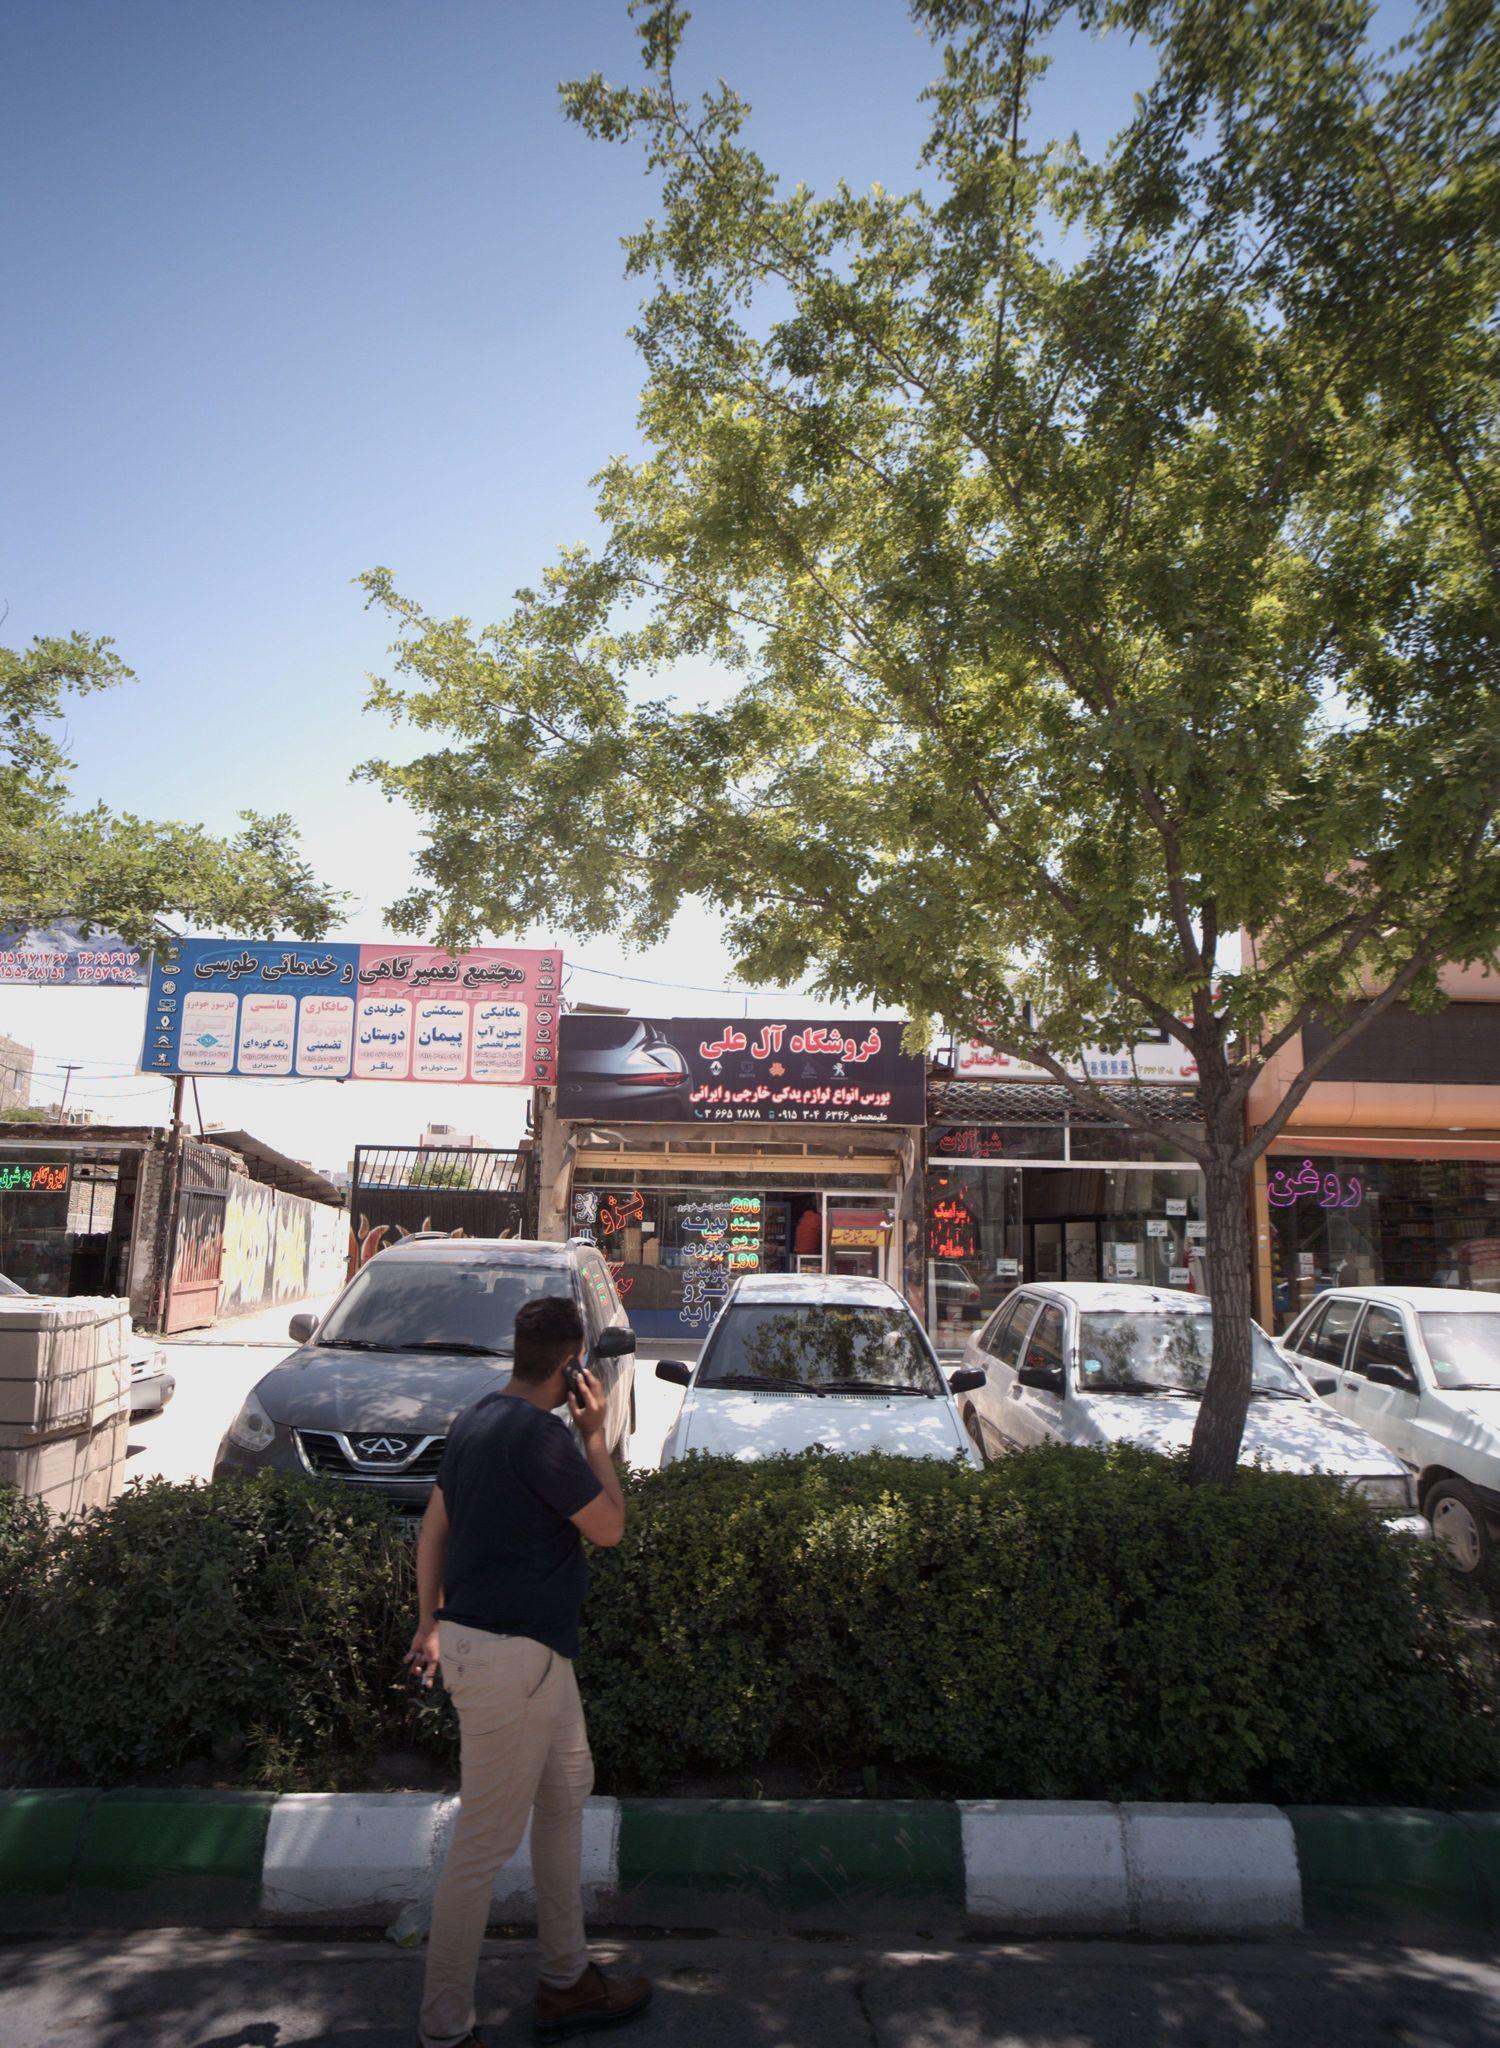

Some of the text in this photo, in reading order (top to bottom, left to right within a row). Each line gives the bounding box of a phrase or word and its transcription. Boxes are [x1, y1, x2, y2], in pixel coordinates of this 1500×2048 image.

[195, 951, 259, 980] طوسی
[261, 953, 338, 981] خدماتی
[340, 965, 354, 984] و
[463, 962, 526, 988] مجتمع
[244, 983, 347, 996] MOTORS
[362, 986, 525, 1001] HYUNDAI
[250, 1001, 288, 1012] نقاشی
[305, 1001, 349, 1014] صافکاری
[364, 1004, 406, 1017] جلوبندی
[422, 1004, 464, 1018] سیمکشی
[481, 1007, 521, 1019] مکانیکی
[360, 1027, 406, 1045] دوستان
[418, 1026, 463, 1048] پیمان
[699, 1024, 882, 1063] فروشگاه آل علی
[306, 1039, 342, 1052] تضمینی
[370, 1061, 394, 1072] باقر
[689, 1084, 891, 1105] بورس انواع لوازم یدکی خارجی و ایرانی
[1266, 1159, 1363, 1208] روغن
[600, 1190, 645, 1236] پژو
[731, 1197, 761, 1214] 206
[730, 1217, 760, 1232] سمند
[681, 1241, 731, 1257] موتوری
[728, 1252, 759, 1269] L90
[682, 1262, 731, 1282] جلوبندی
[682, 1280, 730, 1302] پژو
